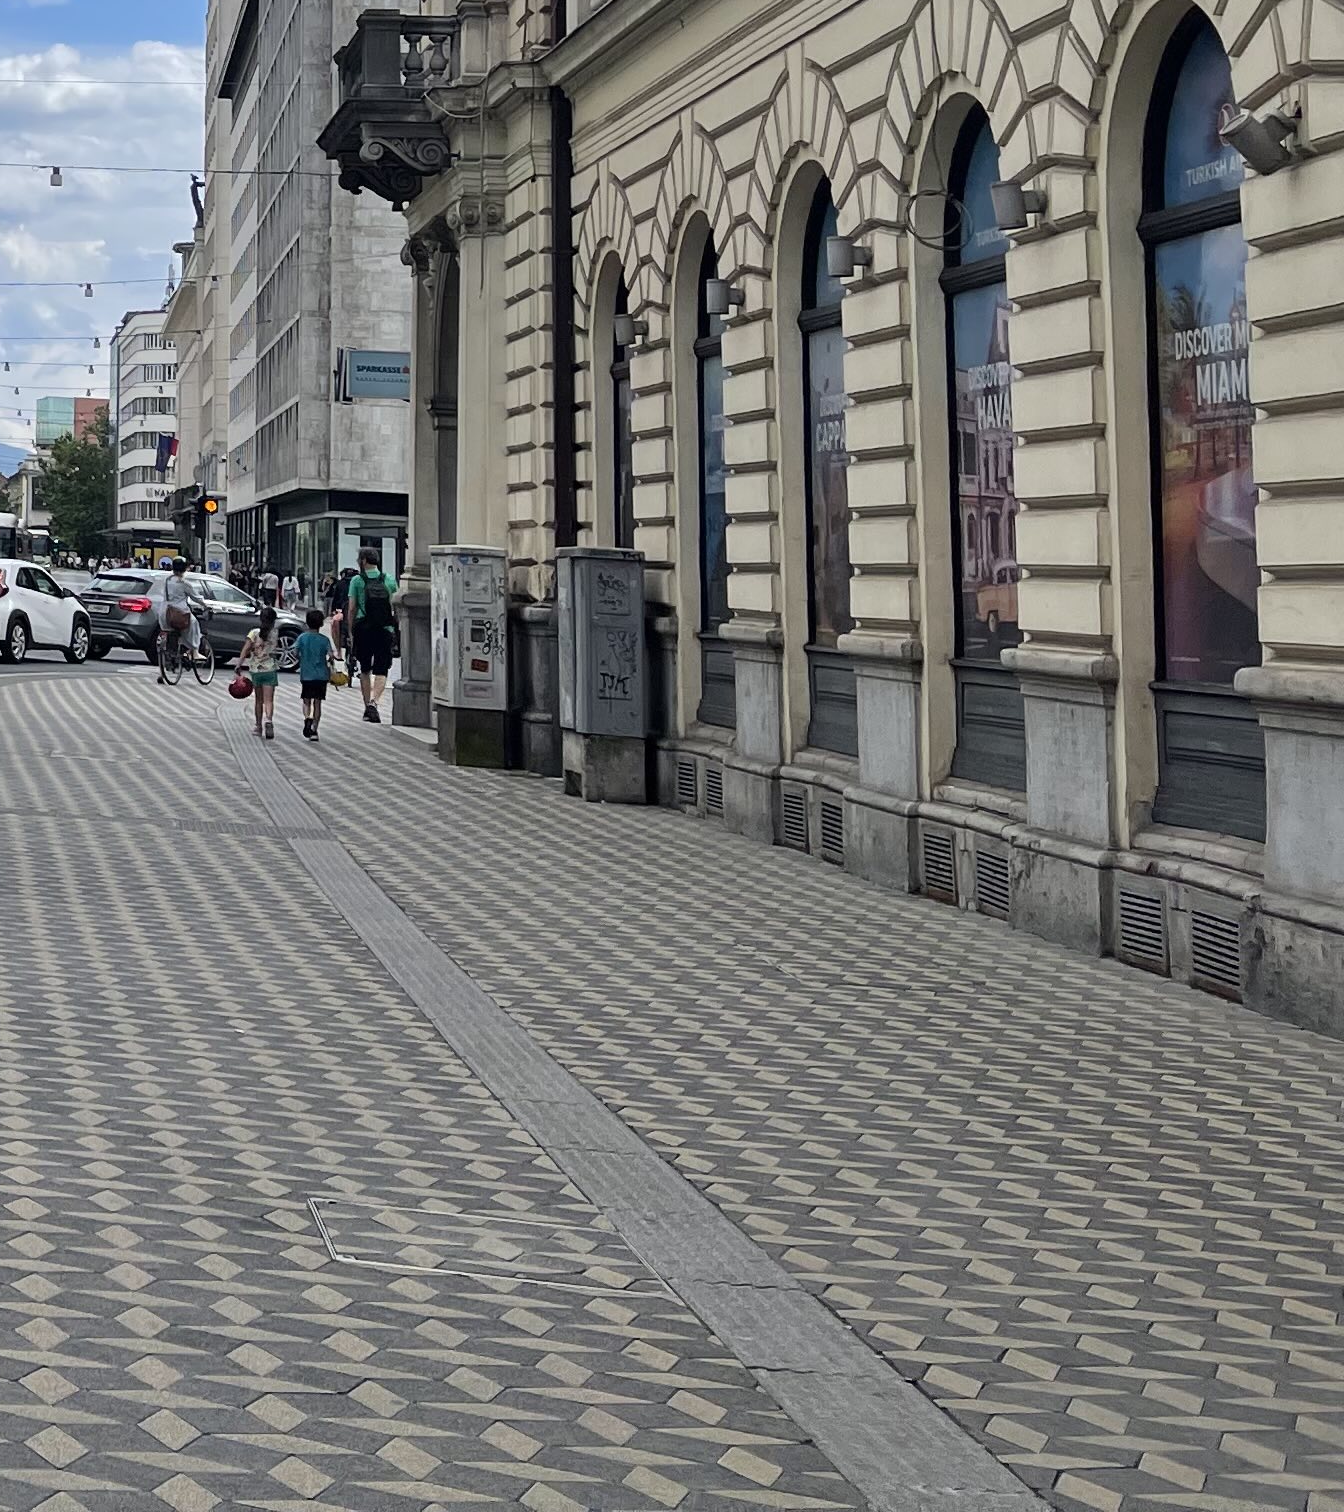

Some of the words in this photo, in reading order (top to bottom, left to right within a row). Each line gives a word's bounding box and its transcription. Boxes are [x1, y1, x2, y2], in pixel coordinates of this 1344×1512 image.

[1185, 157, 1227, 187] TURKISH
[1174, 322, 1233, 361] DISCOVER
[356, 365, 401, 374] SPARKASSE
